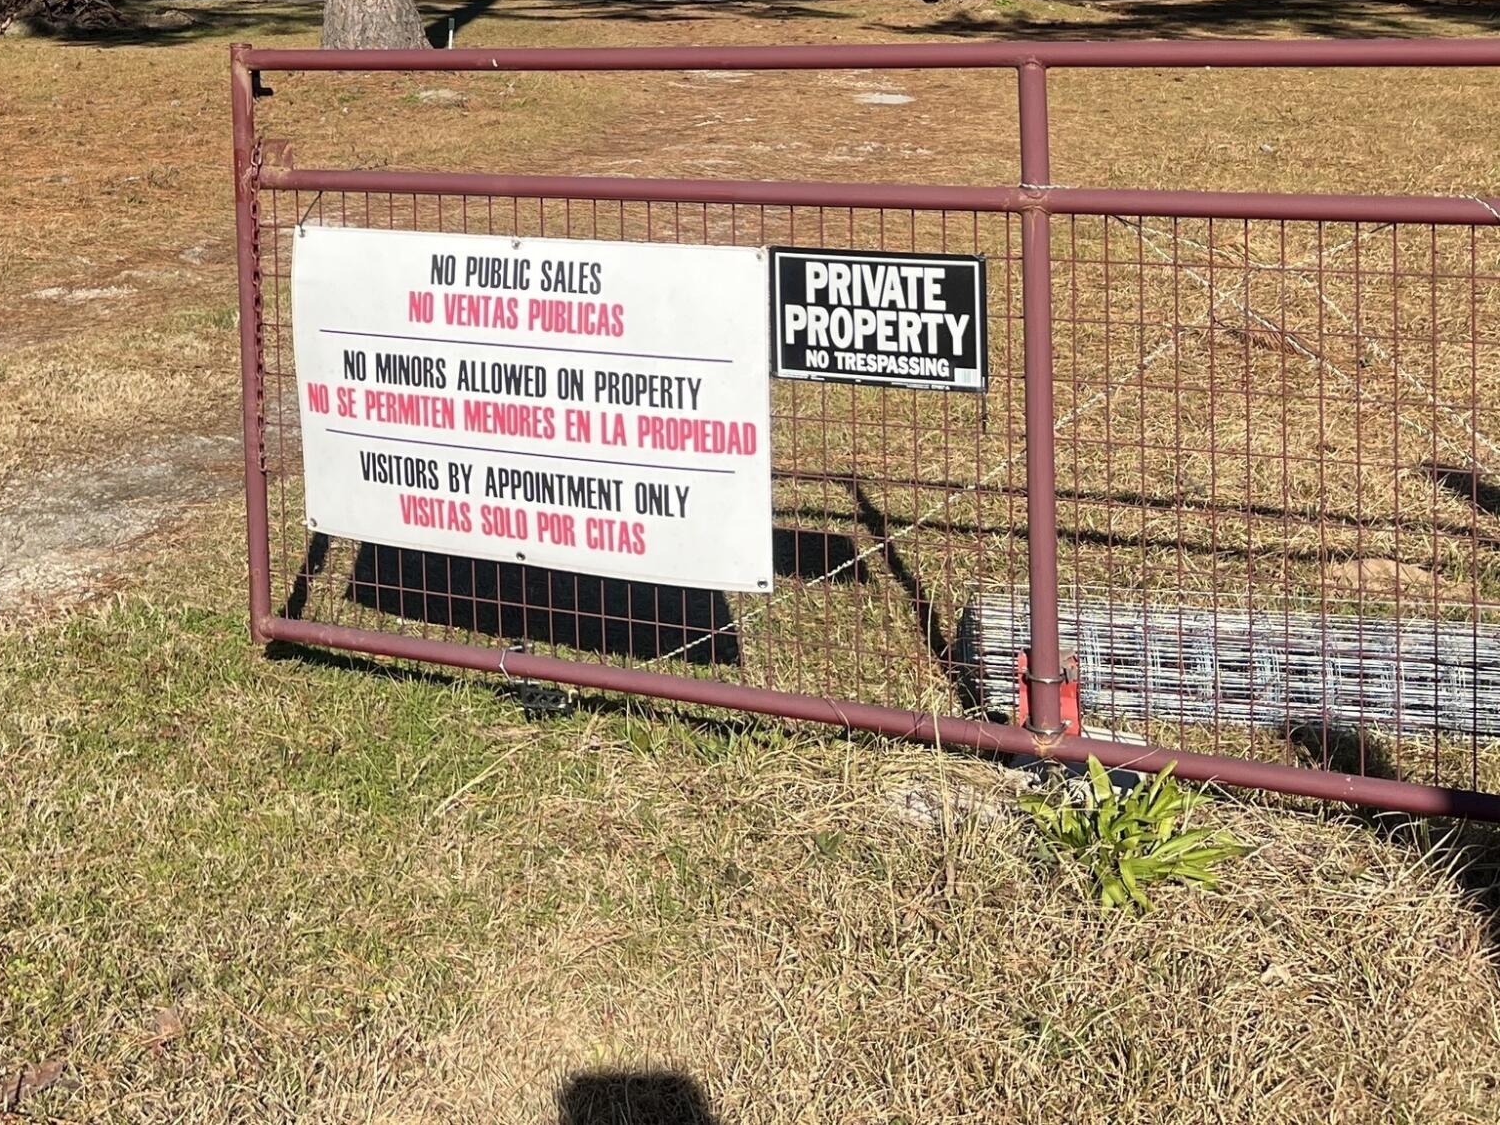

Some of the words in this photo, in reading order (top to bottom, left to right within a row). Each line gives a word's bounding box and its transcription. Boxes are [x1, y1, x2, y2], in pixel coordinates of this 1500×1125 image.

[431, 254, 456, 286] NO
[465, 256, 531, 291] PUBLIC
[540, 260, 601, 295] SALES
[805, 262, 947, 312] PRIVATE
[409, 291, 434, 324] NO
[444, 293, 519, 331] VENTAS
[528, 298, 624, 337] PUBLICAS
[784, 304, 970, 355] PROPERTY
[343, 349, 367, 382] NO
[375, 352, 447, 390] MINORS
[457, 360, 547, 398] ALLOWED
[557, 368, 584, 402] ON
[595, 371, 702, 411] PROPERTY
[805, 349, 830, 369] NO
[833, 351, 950, 378] TRESPASSING
[307, 382, 330, 415] NO
[336, 386, 357, 419] SE
[365, 389, 455, 430] PERMITEN
[463, 399, 556, 440] MENORES
[565, 409, 591, 443] EN
[601, 411, 627, 445] LA
[637, 415, 757, 456] PROPIEDAD
[359, 450, 439, 491] VISITORS
[448, 462, 473, 495] BY
[485, 466, 623, 512] APPOINTMENT
[635, 482, 689, 518] ONLY
[400, 493, 473, 533] VISITAS
[480, 504, 528, 540] SOLO
[536, 511, 576, 546] POR
[585, 517, 646, 556] CITAS
